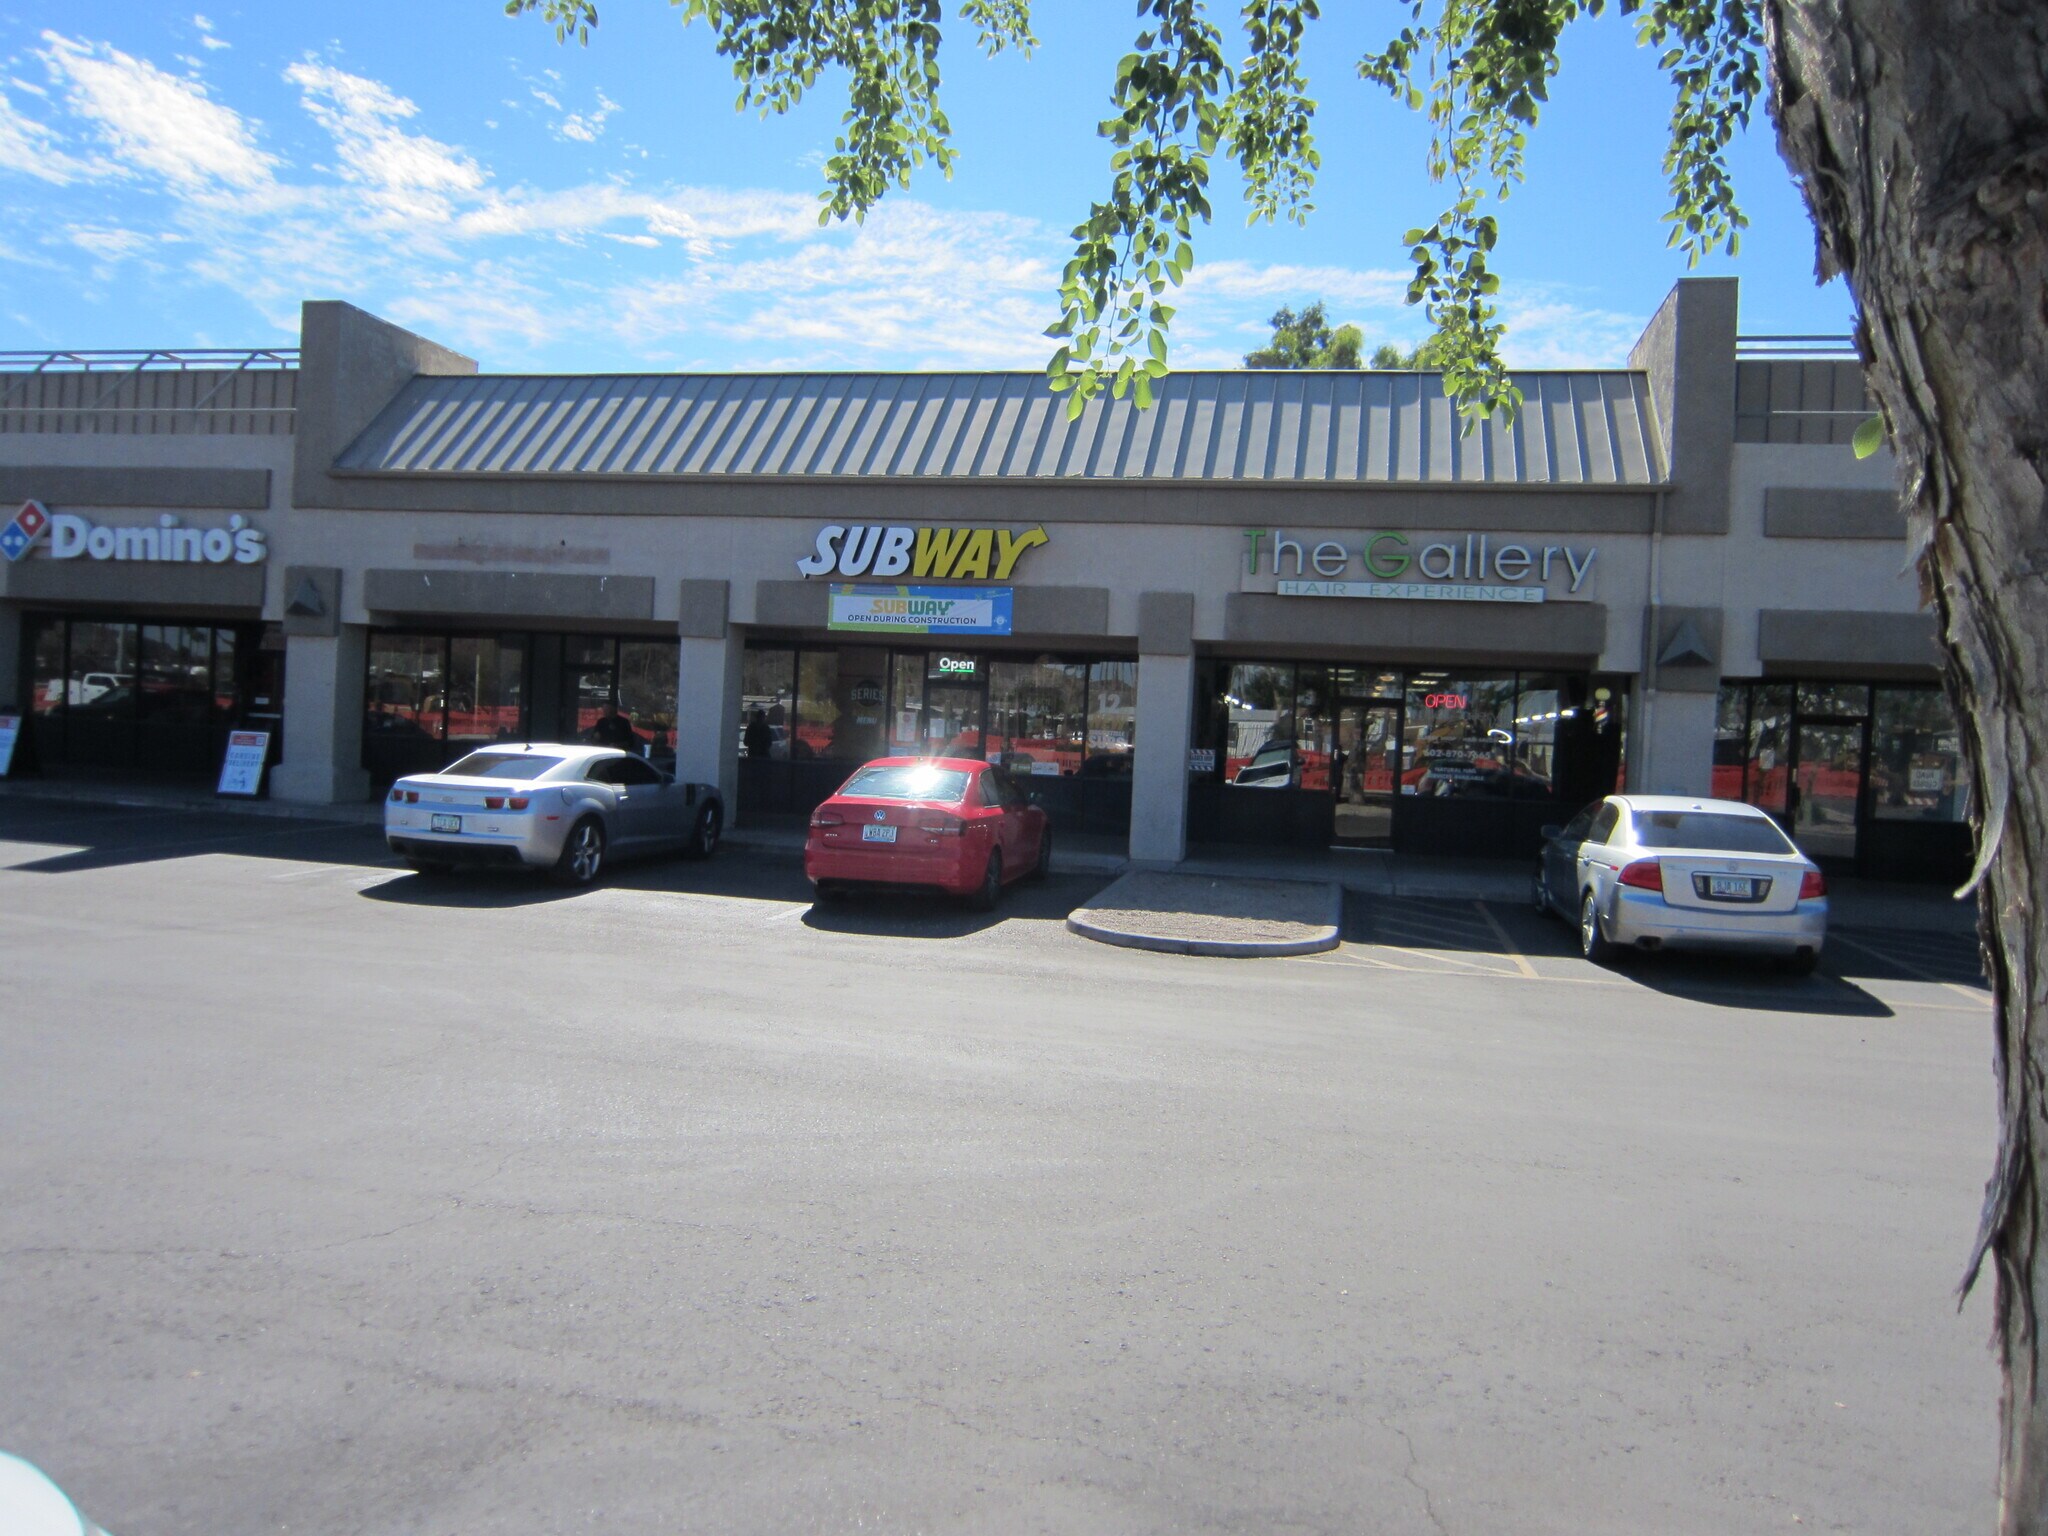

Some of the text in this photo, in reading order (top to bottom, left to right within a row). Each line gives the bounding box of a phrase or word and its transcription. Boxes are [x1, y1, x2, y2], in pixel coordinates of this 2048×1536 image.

[51, 514, 267, 564] Domino's
[797, 524, 1049, 581] SUBWAY
[1243, 529, 1596, 593] The Gallery
[1285, 581, 1536, 601] HAIR EXPERIENCE
[870, 599, 956, 616] SUBWAY
[848, 614, 977, 625] OPEN DURING CONSTRUCTION
[939, 657, 976, 673] Open
[1425, 694, 1468, 709] OPEN
